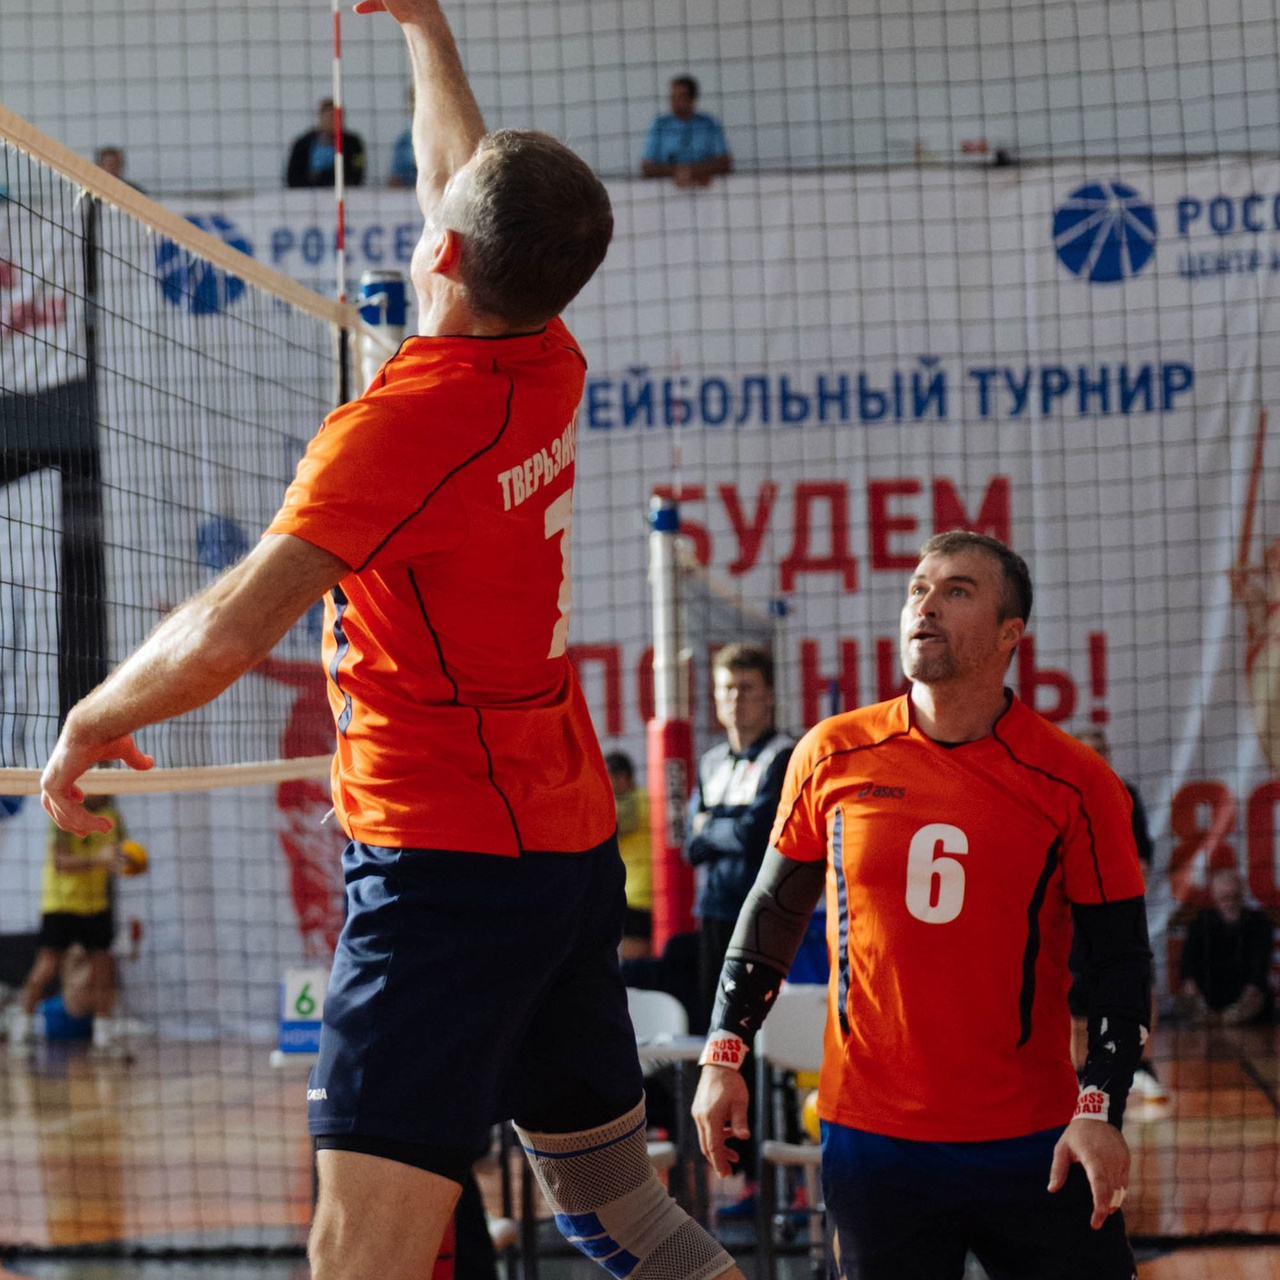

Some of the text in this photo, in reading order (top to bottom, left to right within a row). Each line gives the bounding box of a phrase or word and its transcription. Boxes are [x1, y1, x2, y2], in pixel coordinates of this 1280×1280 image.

[271, 224, 417, 266] РОССЕ
[1177, 193, 1280, 237] РОС
[587, 354, 1194, 431] ЕЙБОЛЬНЫЙ ТУРНИР
[651, 474, 1013, 594] БУДЕМ
[905, 822, 969, 925] 6
[295, 982, 316, 1017] 6
